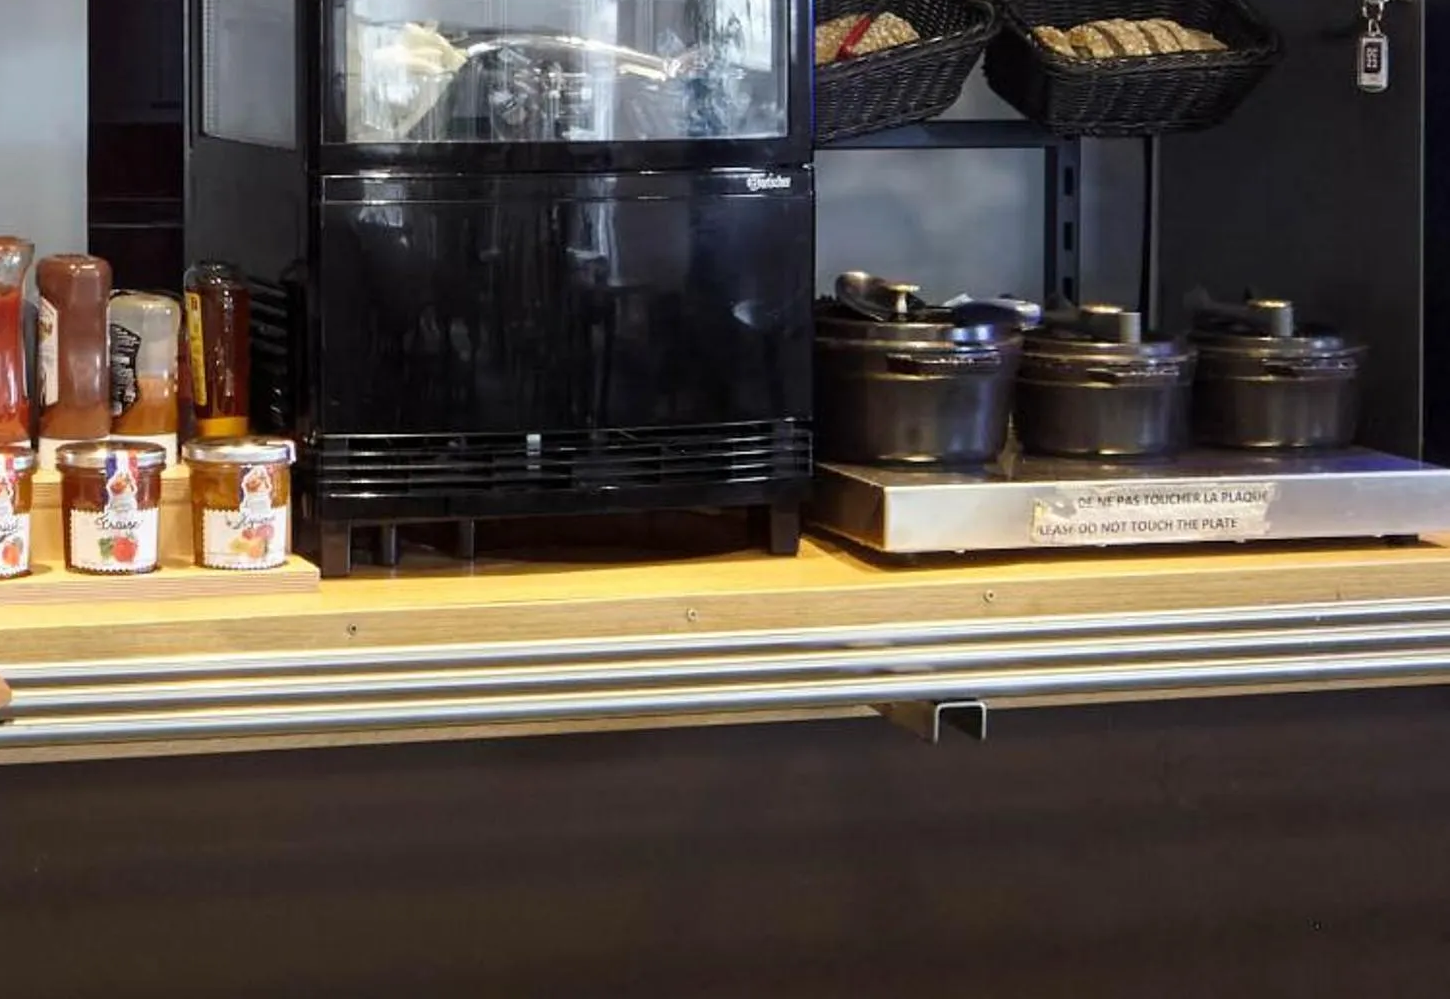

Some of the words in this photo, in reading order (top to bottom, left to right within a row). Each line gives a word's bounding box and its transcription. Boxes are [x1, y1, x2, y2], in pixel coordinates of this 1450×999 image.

[1117, 494, 1140, 505] PAS
[1144, 492, 1199, 504] TOUCHER
[1204, 492, 1218, 503] LA
[1078, 524, 1098, 533] DO
[1102, 521, 1126, 532] NOT
[1131, 520, 1172, 531] TOUCH
[1177, 519, 1198, 530] THE
[1202, 517, 1239, 529] PLATE
